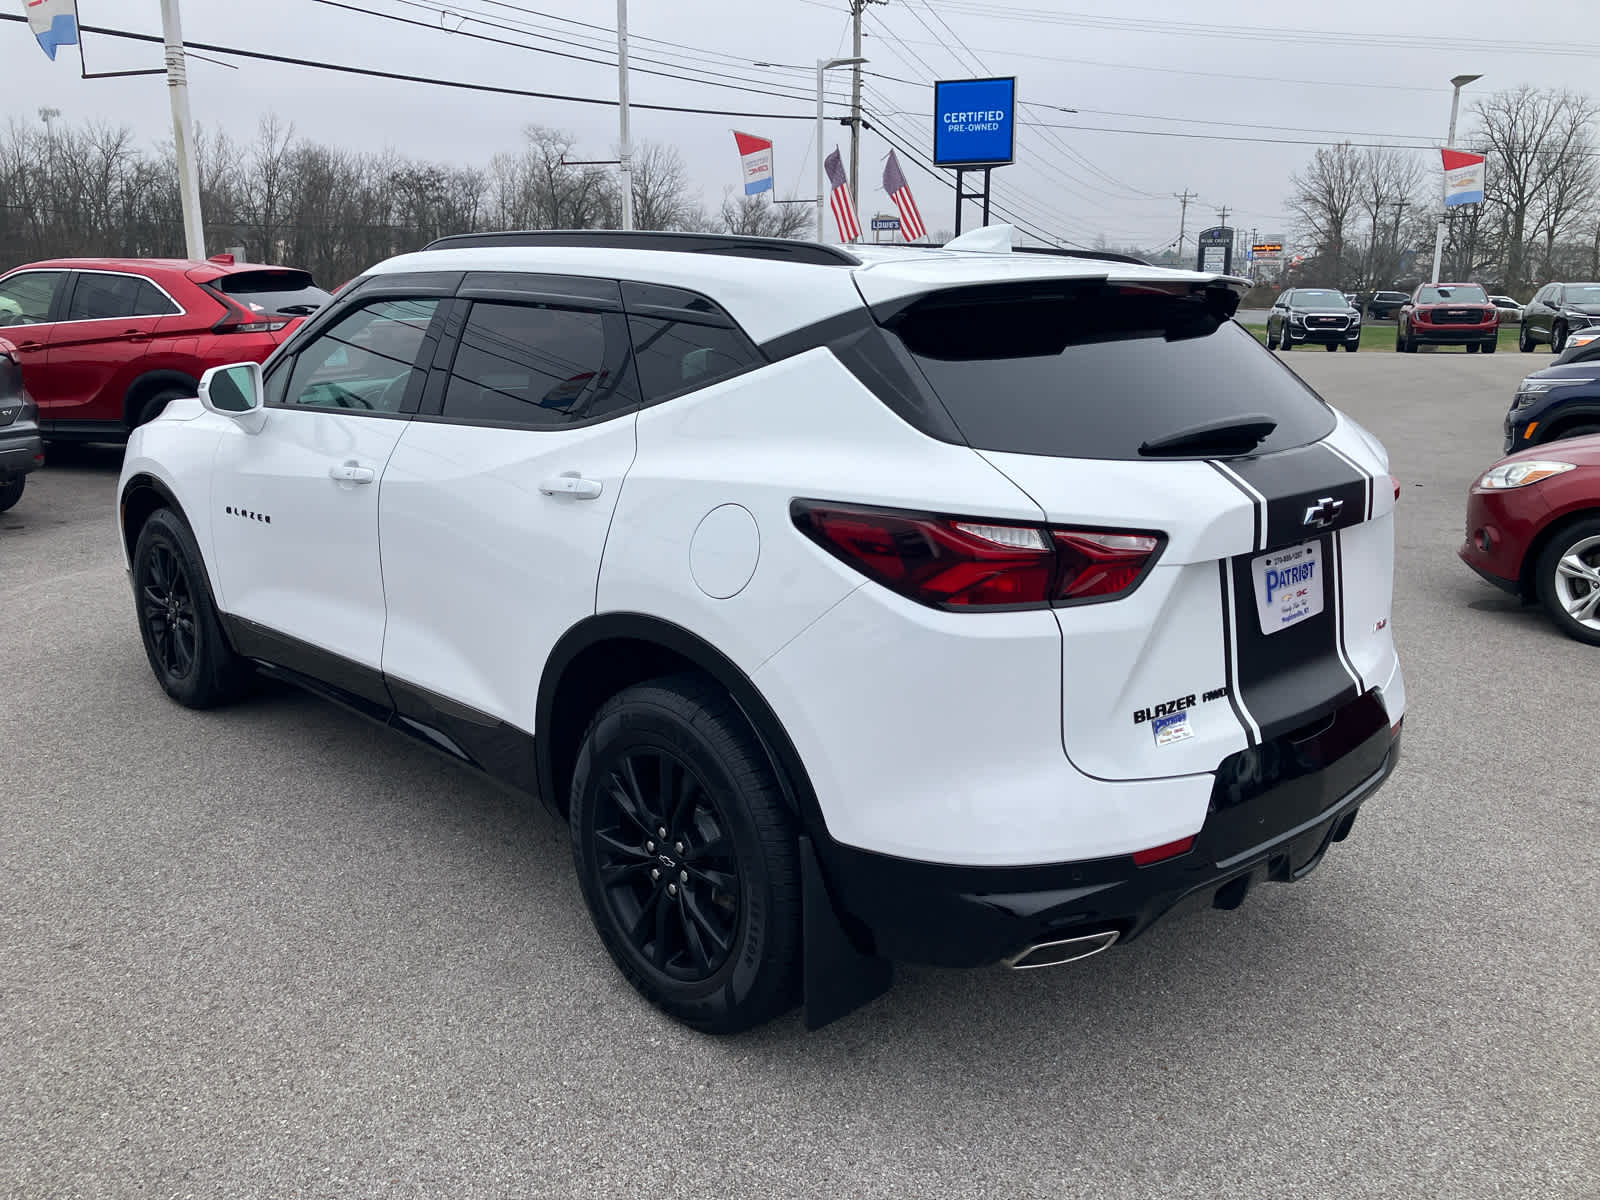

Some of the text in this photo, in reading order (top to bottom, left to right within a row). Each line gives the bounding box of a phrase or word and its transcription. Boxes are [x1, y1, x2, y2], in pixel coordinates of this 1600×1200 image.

[943, 110, 1004, 123] CERTIFIED
[948, 122, 999, 133] PRE-OWNED
[226, 506, 271, 524] BLAZER
[1265, 562, 1315, 603] PATRIOT
[1133, 693, 1197, 725] BLAZER
